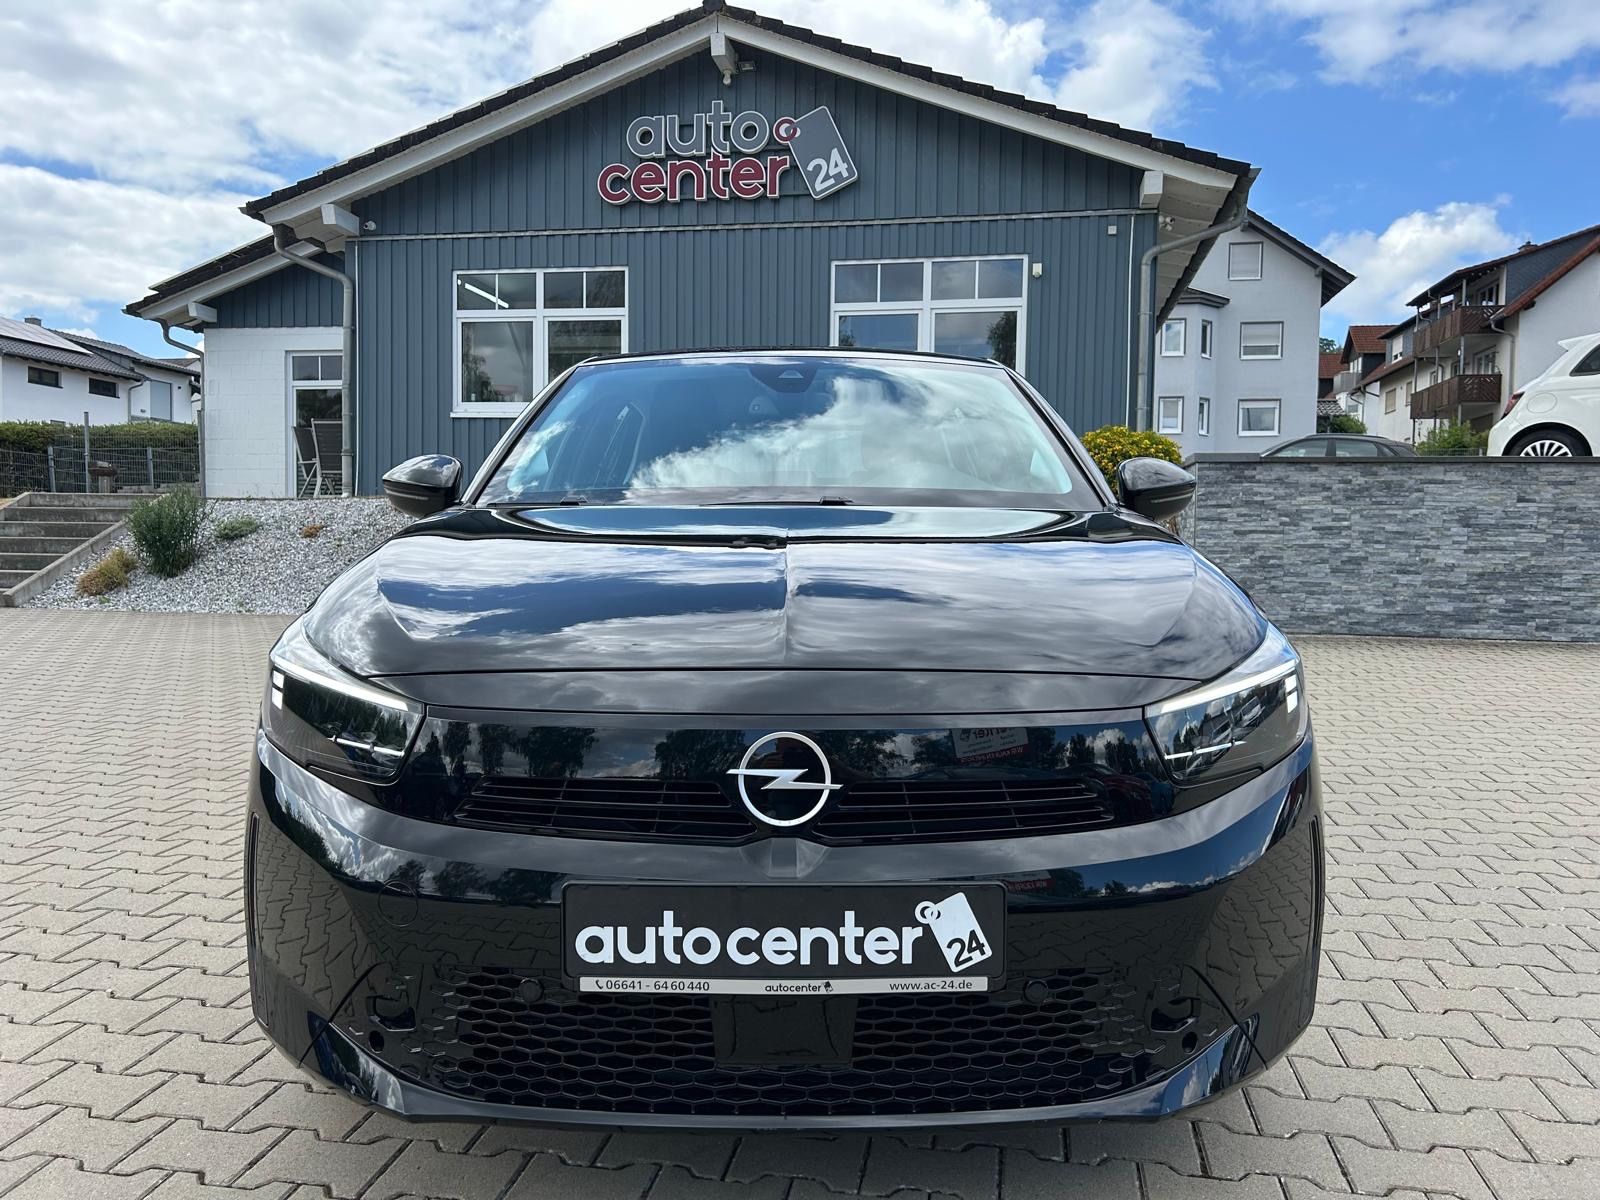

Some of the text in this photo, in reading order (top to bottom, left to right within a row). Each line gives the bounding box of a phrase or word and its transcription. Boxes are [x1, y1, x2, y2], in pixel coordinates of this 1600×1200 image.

[626, 100, 769, 158] auto
[597, 150, 790, 204] center
[806, 147, 849, 192] 24
[575, 910, 923, 965] autocenter
[947, 929, 987, 967] 24
[605, 979, 643, 990] 06641
[764, 981, 822, 993] autocenter
[889, 979, 973, 991] www.ac-24.de
